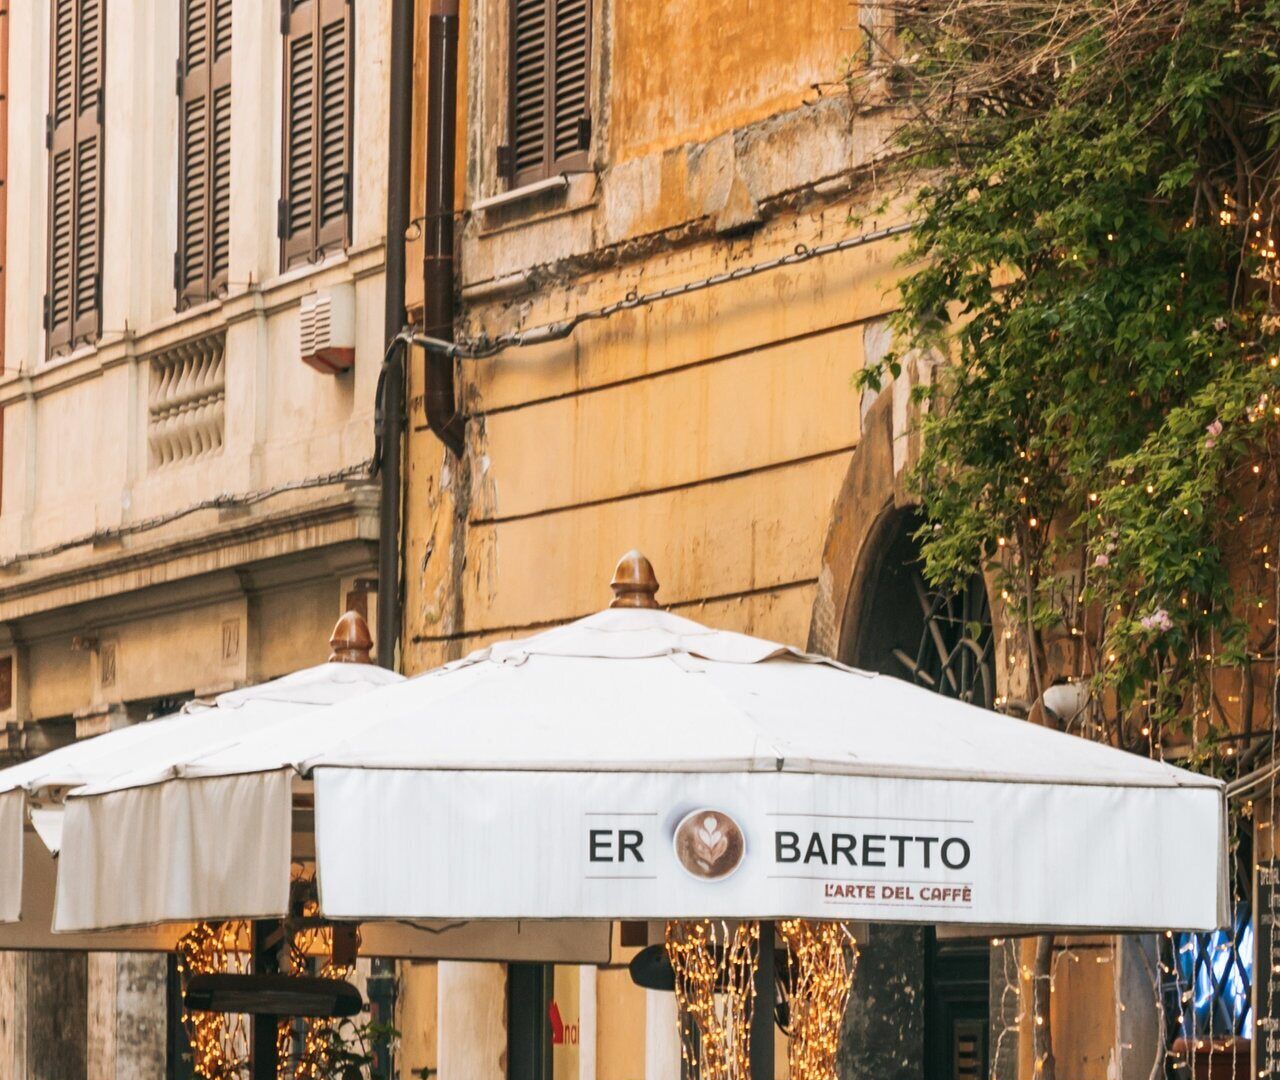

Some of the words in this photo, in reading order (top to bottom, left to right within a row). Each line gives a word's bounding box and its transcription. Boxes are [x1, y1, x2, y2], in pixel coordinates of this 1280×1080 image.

[589, 829, 645, 863] ER
[775, 831, 971, 870] BARETTO
[824, 883, 876, 900] L'ARTE
[881, 886, 915, 901] DEL
[919, 883, 972, 903] CAFFÈ
